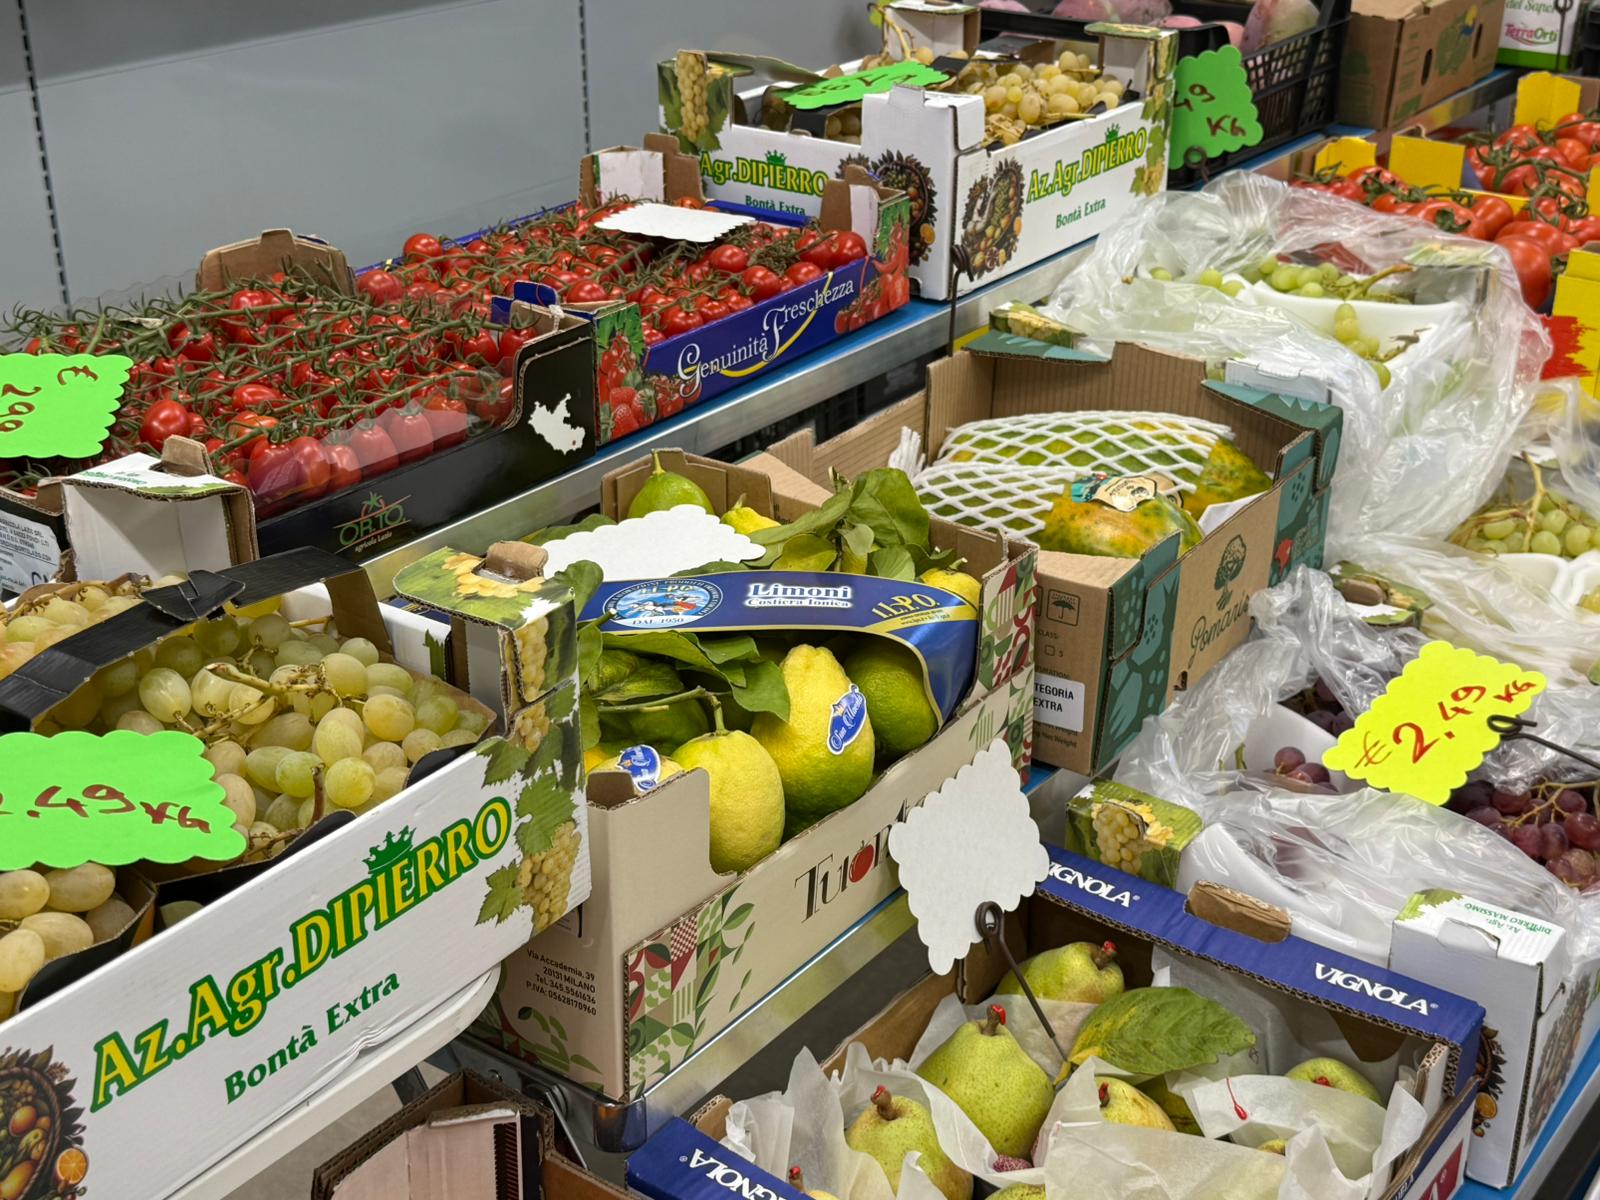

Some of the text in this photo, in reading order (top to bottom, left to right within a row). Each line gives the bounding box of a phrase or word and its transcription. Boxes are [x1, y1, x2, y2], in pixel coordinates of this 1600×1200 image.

[745, 194, 806, 216] Bontà Extra
[1055, 198, 1106, 229] Bontà Extra
[677, 279, 854, 398] Genuinità Freschezza
[746, 598, 850, 607] Costiera Ionica
[748, 582, 853, 600] Limoni
[1033, 697, 1064, 713] EXTRA
[1354, 730, 1392, 769] €
[1392, 685, 1487, 764] 2.49
[1464, 902, 1508, 920] MASSIMO
[90, 796, 512, 1112] Az.Agr.DIPIERRO
[527, 949, 540, 960] Via
[585, 970, 595, 981] 39
[543, 966, 596, 993] 20131 MILANO
[1315, 962, 1428, 1016] VIGNOLA
[224, 972, 399, 1104] Bontà Extra
